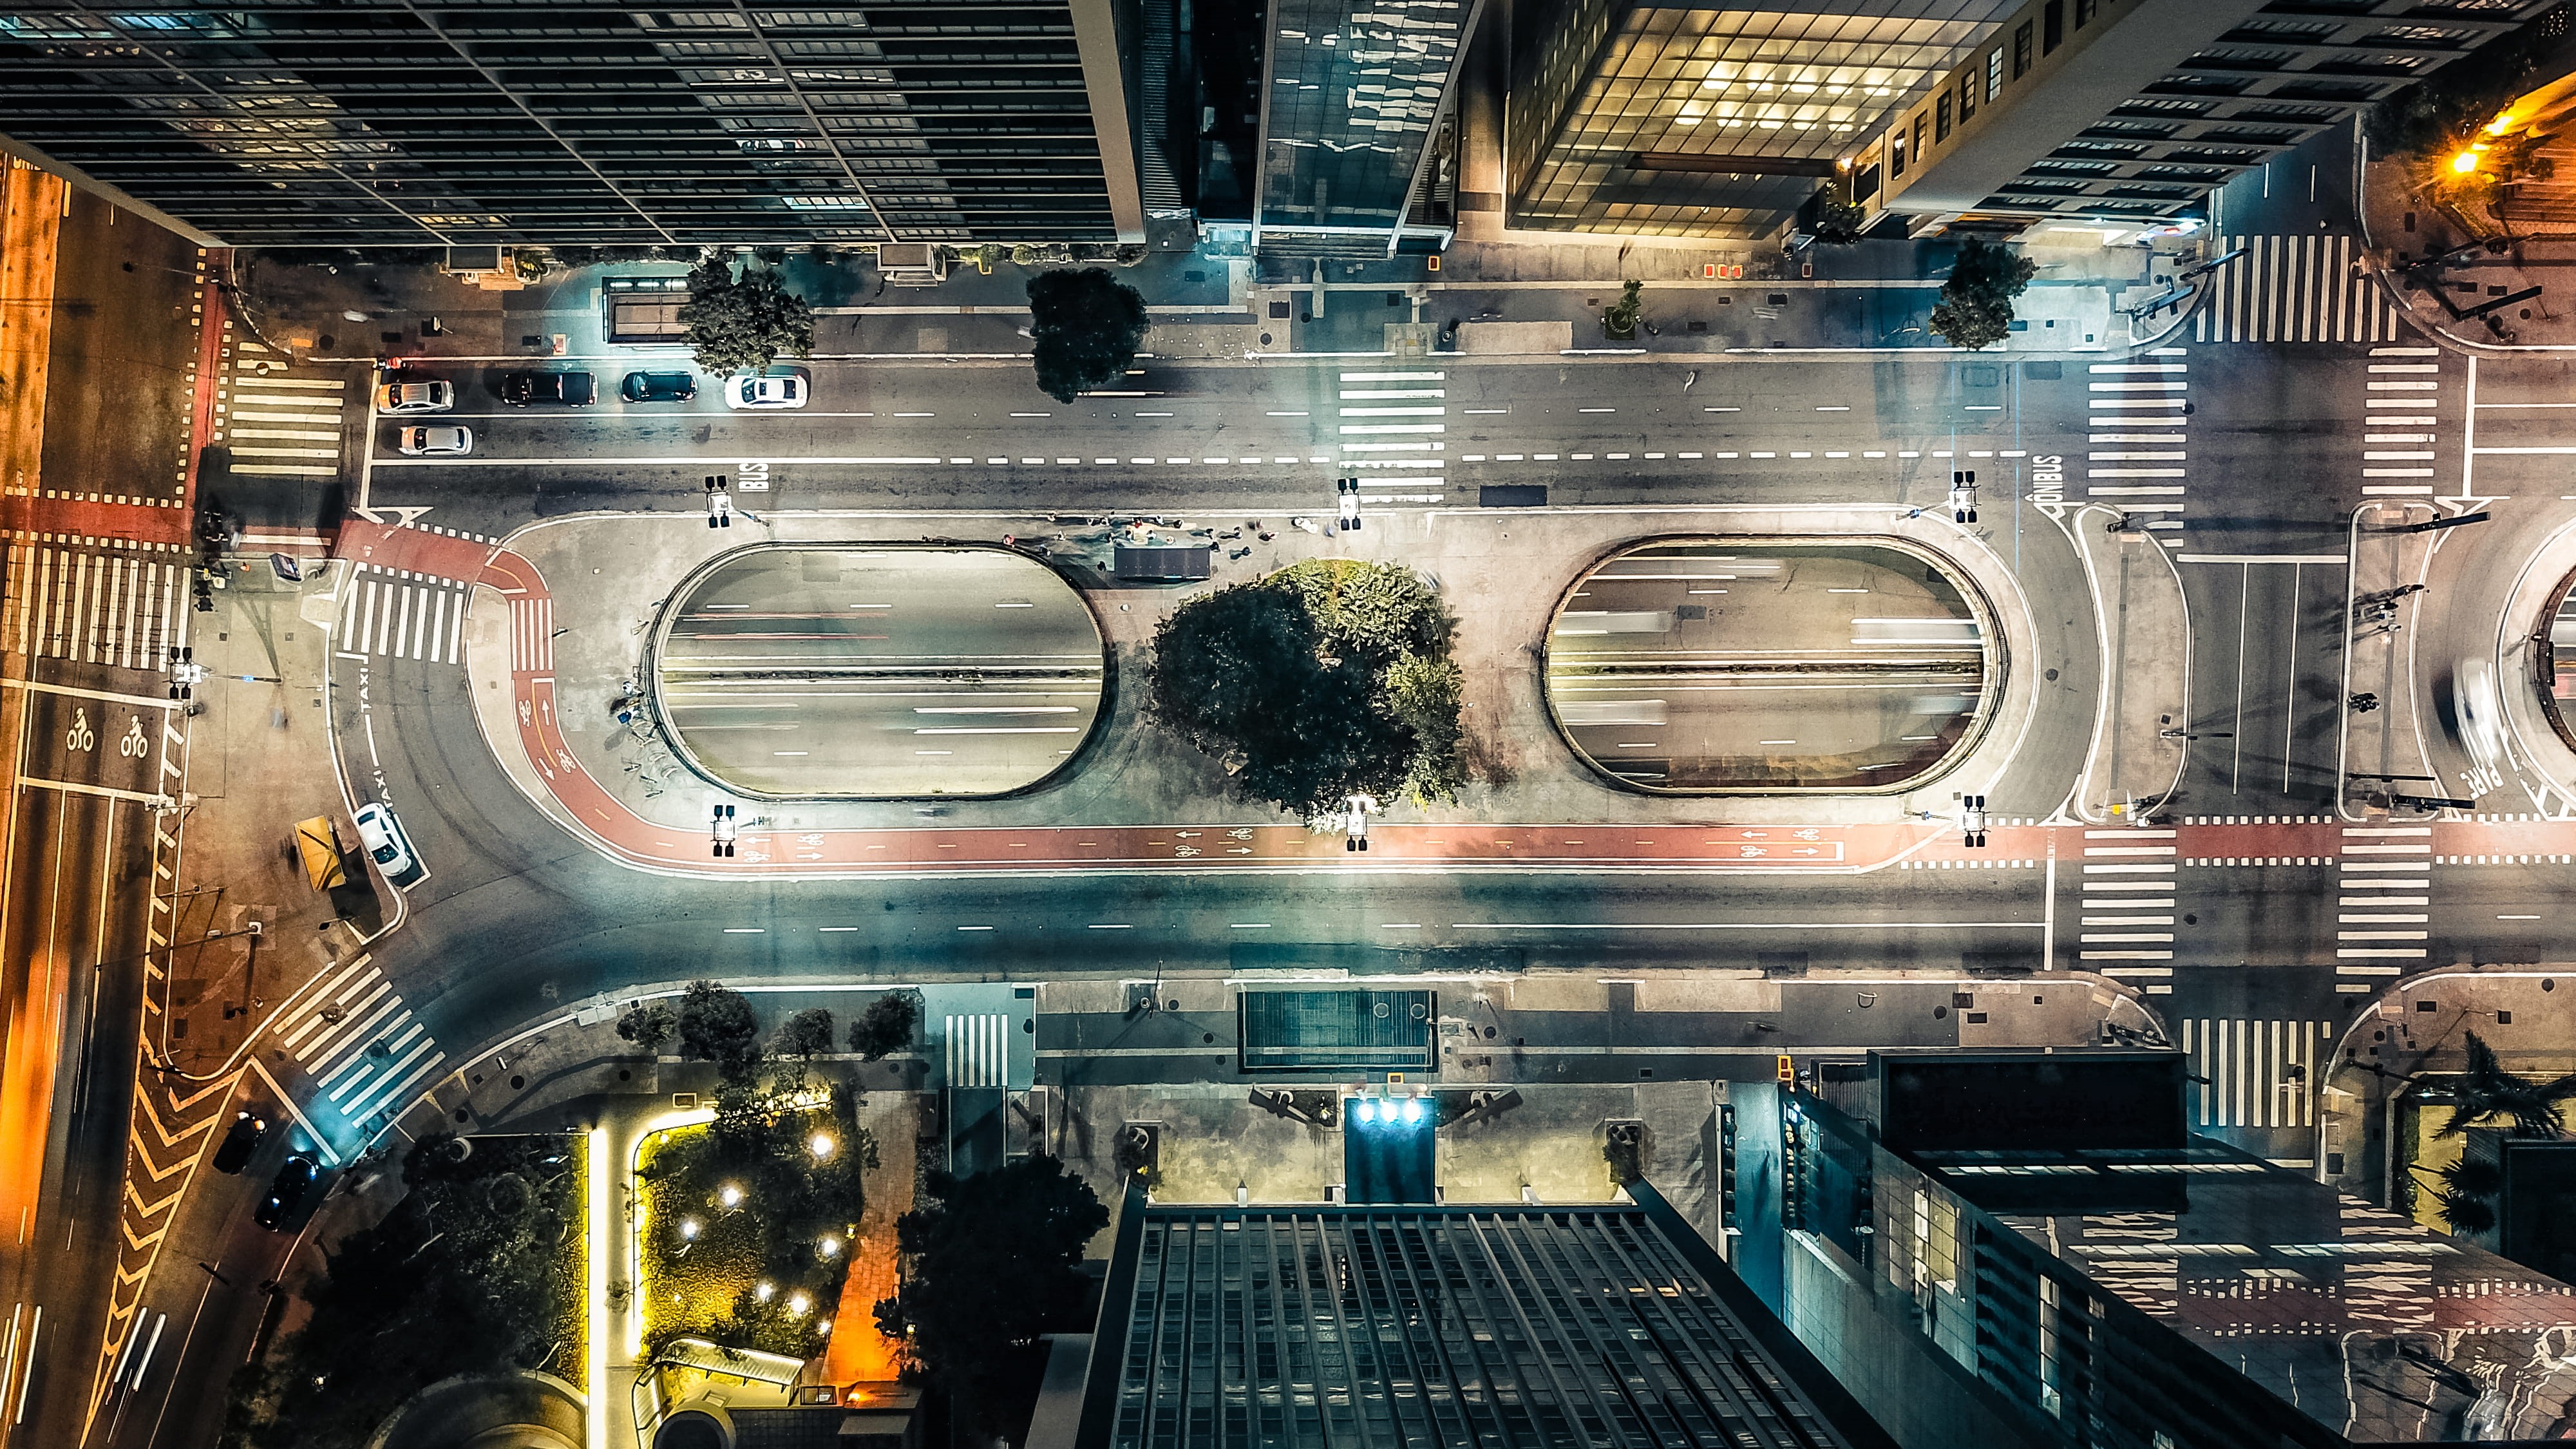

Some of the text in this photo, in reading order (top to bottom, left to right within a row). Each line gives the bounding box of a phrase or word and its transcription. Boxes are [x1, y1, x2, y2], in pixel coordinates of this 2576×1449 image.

[2025, 455, 2063, 502] ÔNIBUS
[360, 667, 372, 713] TAXI
[374, 770, 393, 808] TAXI
[2459, 759, 2504, 800] PARE
